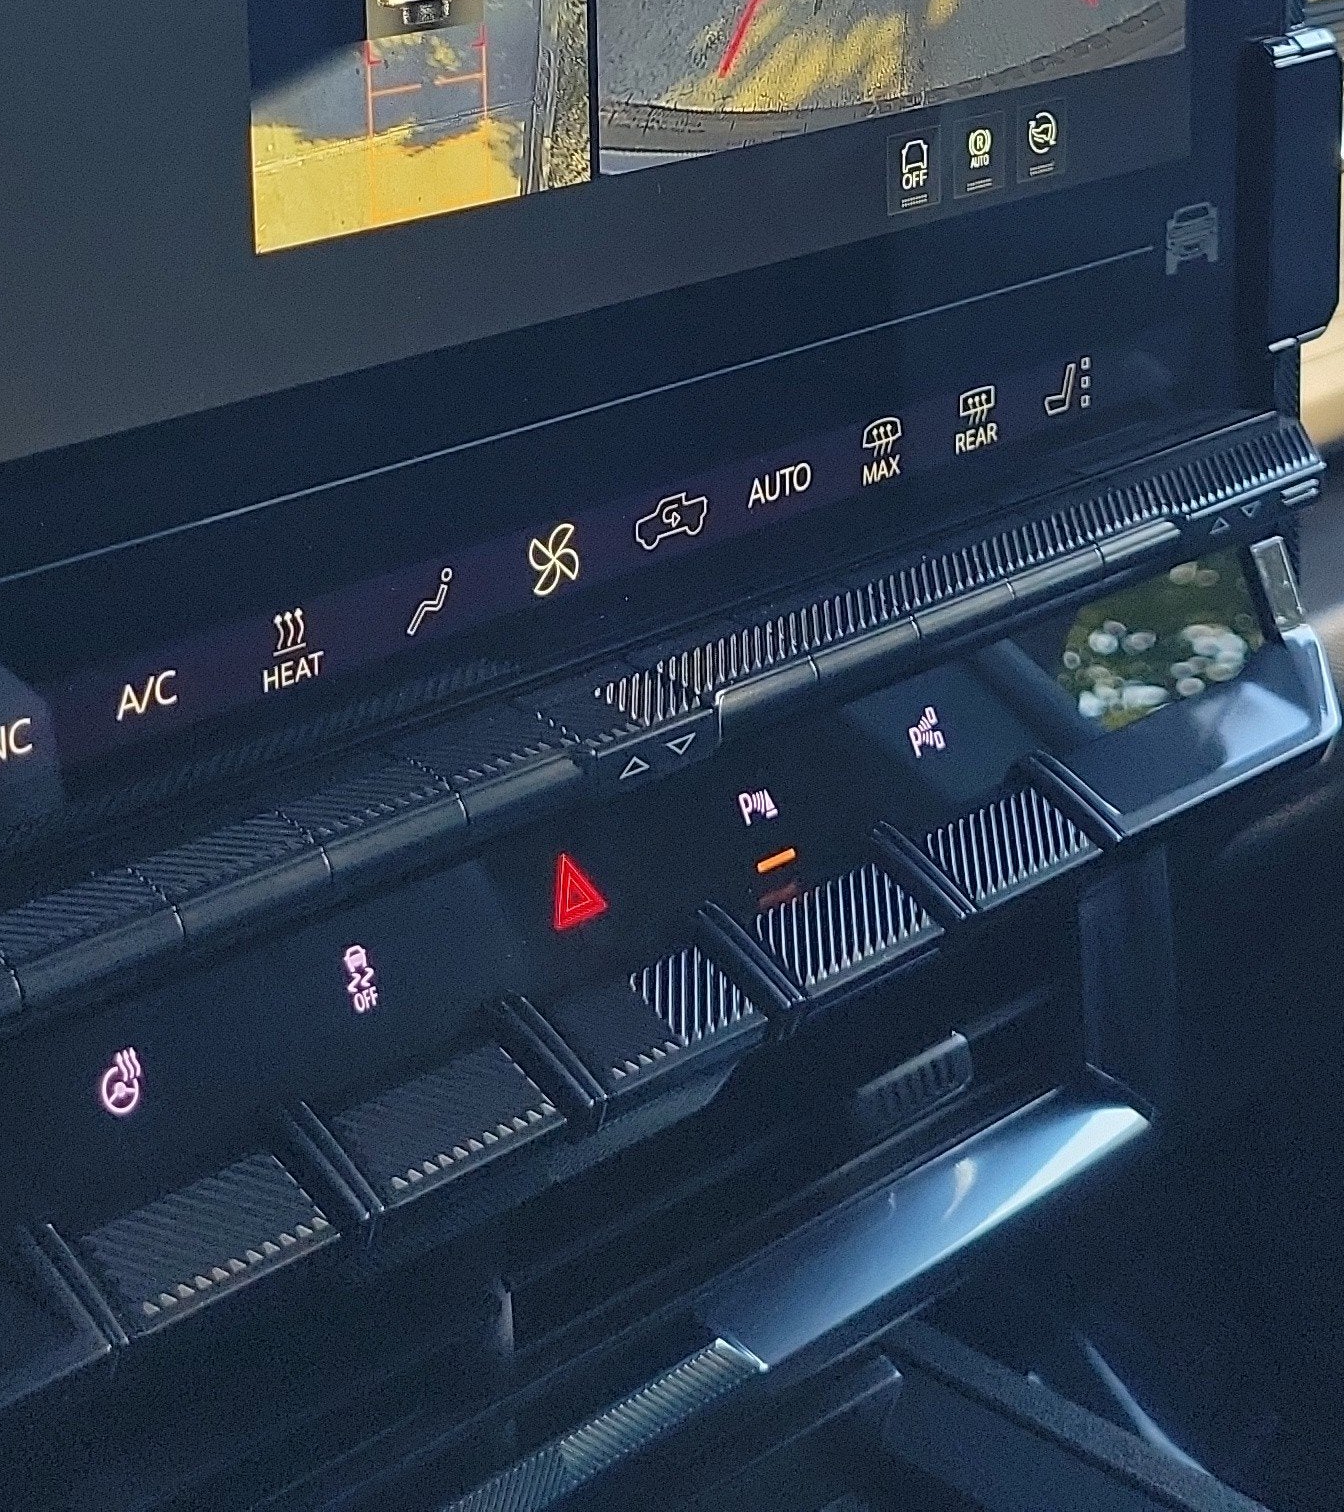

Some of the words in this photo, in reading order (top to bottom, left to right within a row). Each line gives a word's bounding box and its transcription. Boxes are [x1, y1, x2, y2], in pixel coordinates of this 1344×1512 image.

[971, 153, 989, 169] AUTO
[902, 169, 928, 190] OFF
[955, 422, 998, 455] REAR
[747, 462, 812, 509] AUTO
[862, 454, 902, 486] MAX
[262, 650, 325, 693] HEAT
[116, 669, 178, 721] A/C
[354, 986, 379, 1013] OFF
